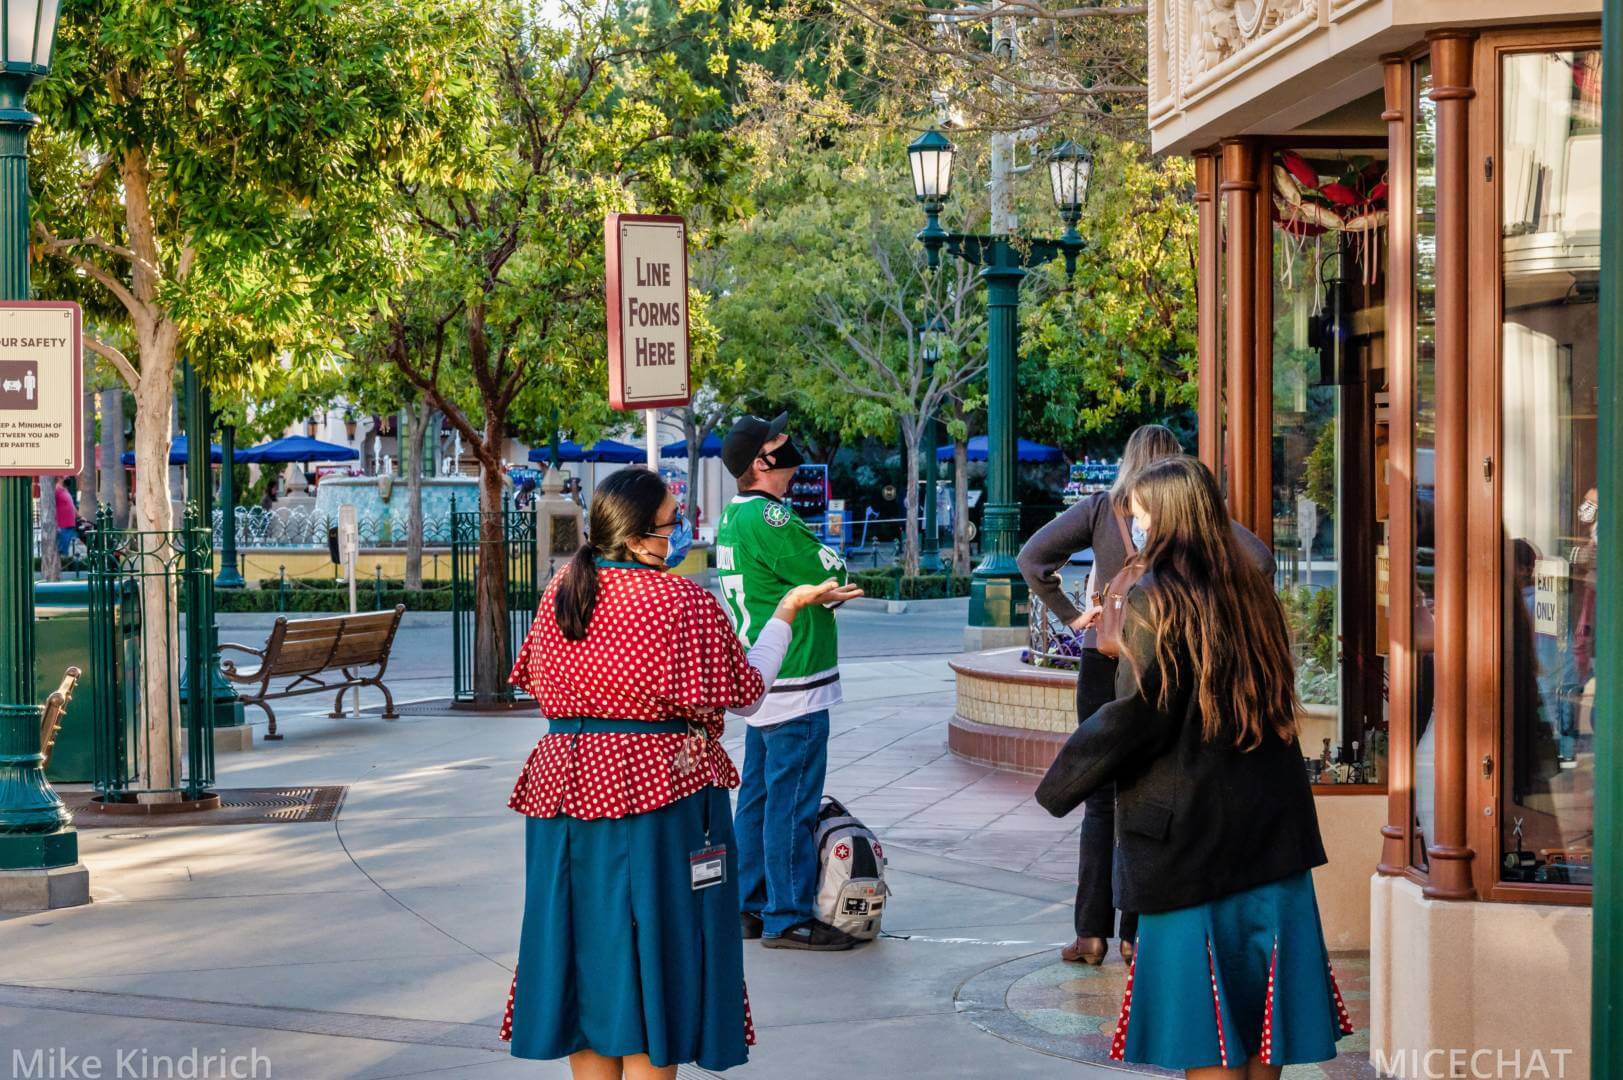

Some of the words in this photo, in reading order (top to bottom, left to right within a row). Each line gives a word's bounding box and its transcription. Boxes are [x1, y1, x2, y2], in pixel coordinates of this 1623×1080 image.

[636, 257, 671, 287] LINE
[628, 297, 680, 327] FORMS
[0, 337, 18, 347] UR
[20, 337, 66, 347] SAFETY
[635, 337, 676, 367] HERE
[18, 421, 52, 429] MINIMUM
[1537, 575, 1555, 592] EXIT
[719, 574, 752, 648] 7
[1536, 602, 1555, 621] ONLY
